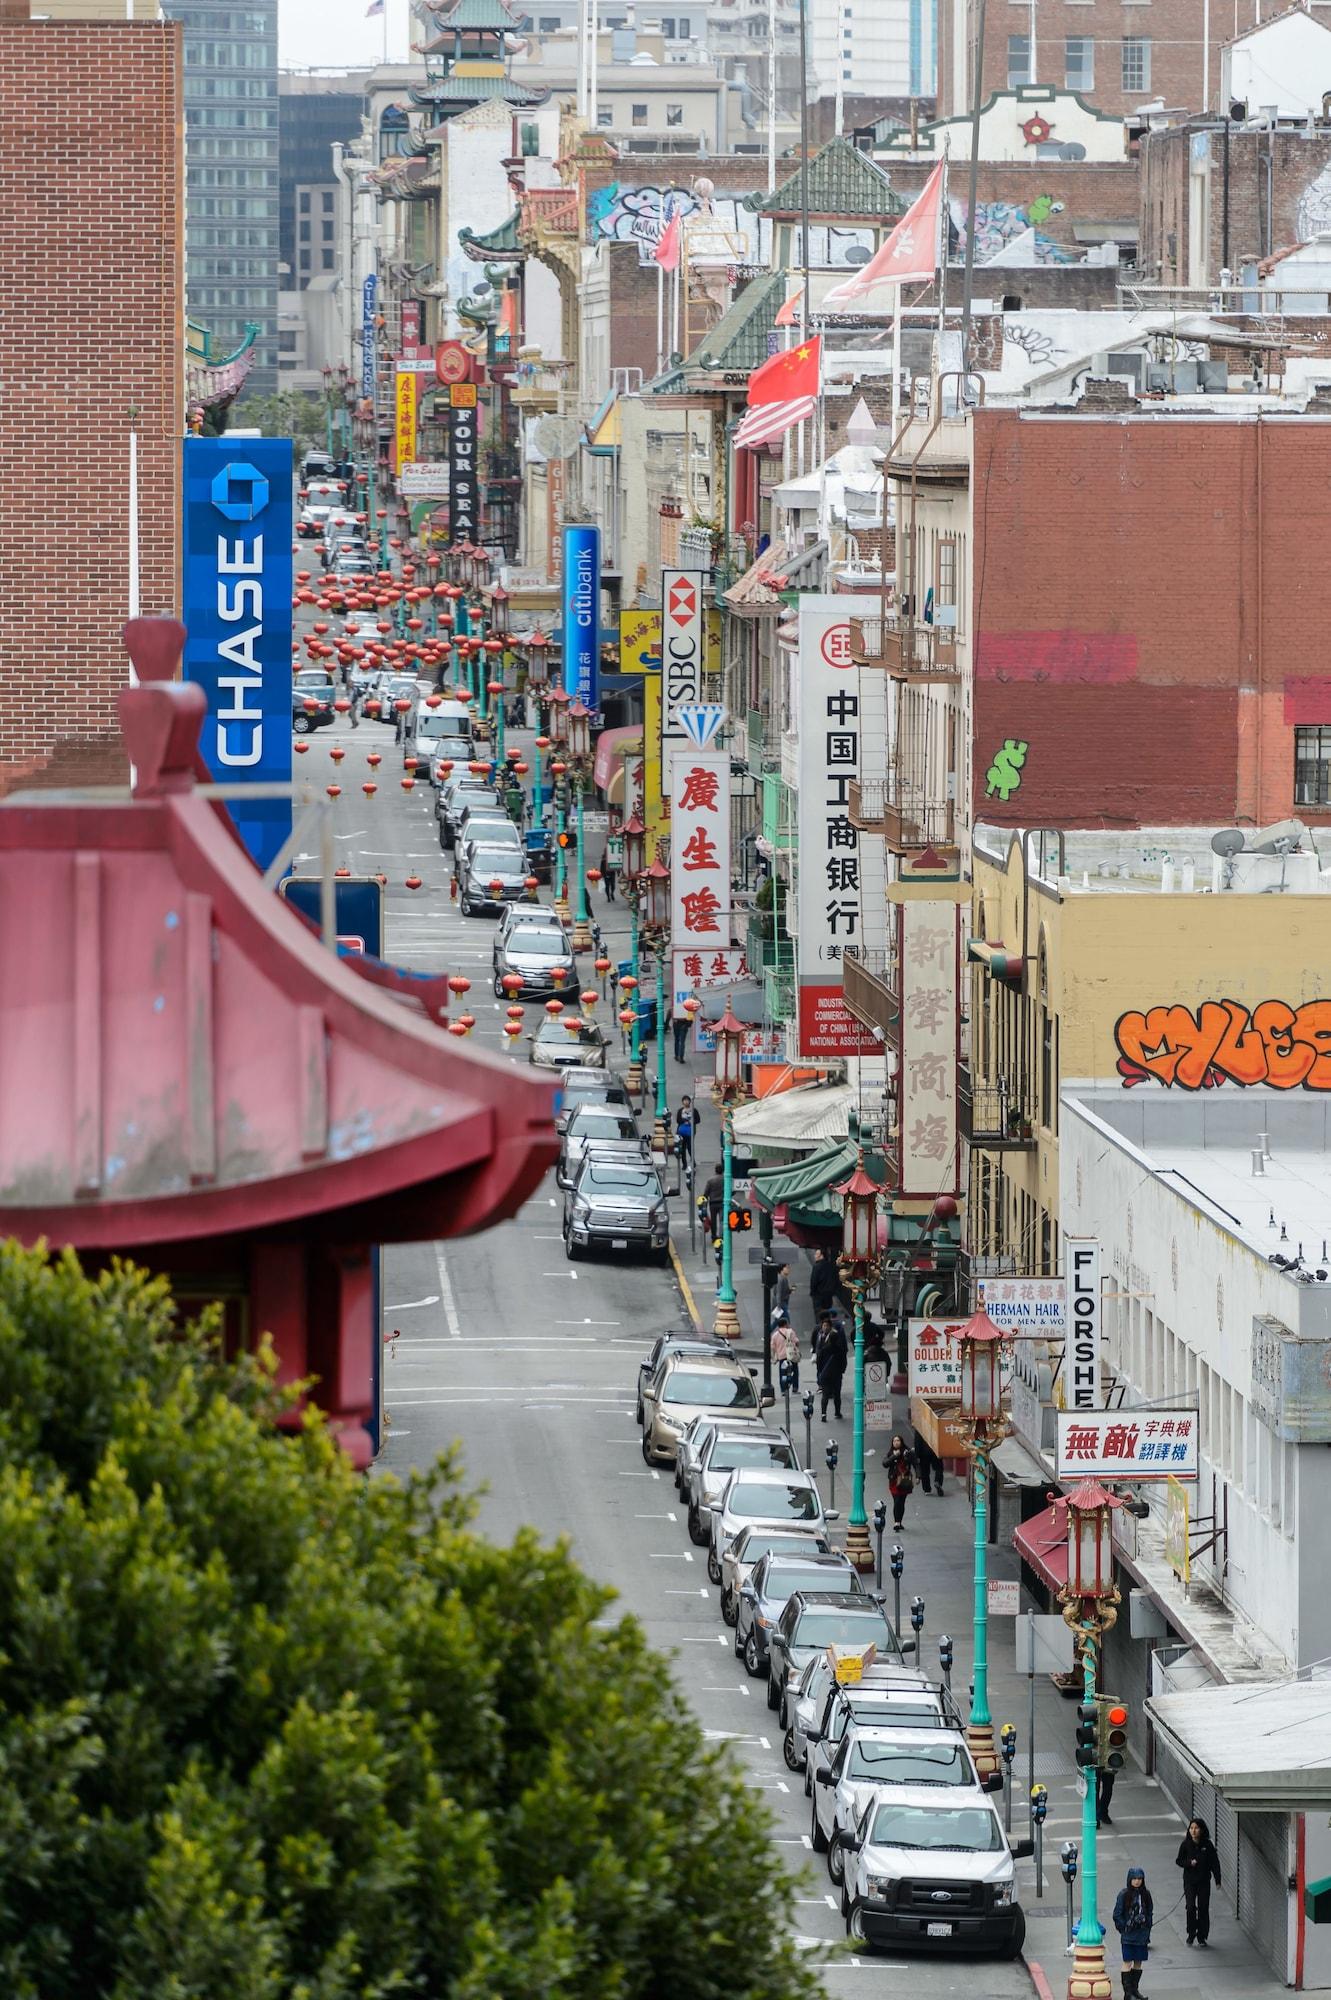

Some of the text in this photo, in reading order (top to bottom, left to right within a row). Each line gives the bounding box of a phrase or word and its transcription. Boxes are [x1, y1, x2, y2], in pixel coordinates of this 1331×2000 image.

[400, 376, 413, 462] 康年海鮮酒
[455, 409, 472, 471] FOUR
[574, 548, 592, 627] citibank
[217, 534, 263, 766] CHASE
[826, 689, 860, 936] 中国工商银行
[678, 767, 721, 933] 廣生隆
[814, 1011, 853, 1021] COMMERCIAL
[819, 1023, 828, 1034] OF
[829, 1023, 849, 1034] CHINA
[809, 1036, 878, 1047] NATIONAL ASSOCATION
[987, 1303, 1059, 1316] HERMAN HAIR
[914, 1348, 952, 1361] GOLDEN
[1143, 1419, 1192, 1438] 字典機
[1065, 1423, 1141, 1460] 無敵
[1138, 1442, 1188, 1461] 翻譯機
[988, 1581, 1019, 1592] NO PARKING
